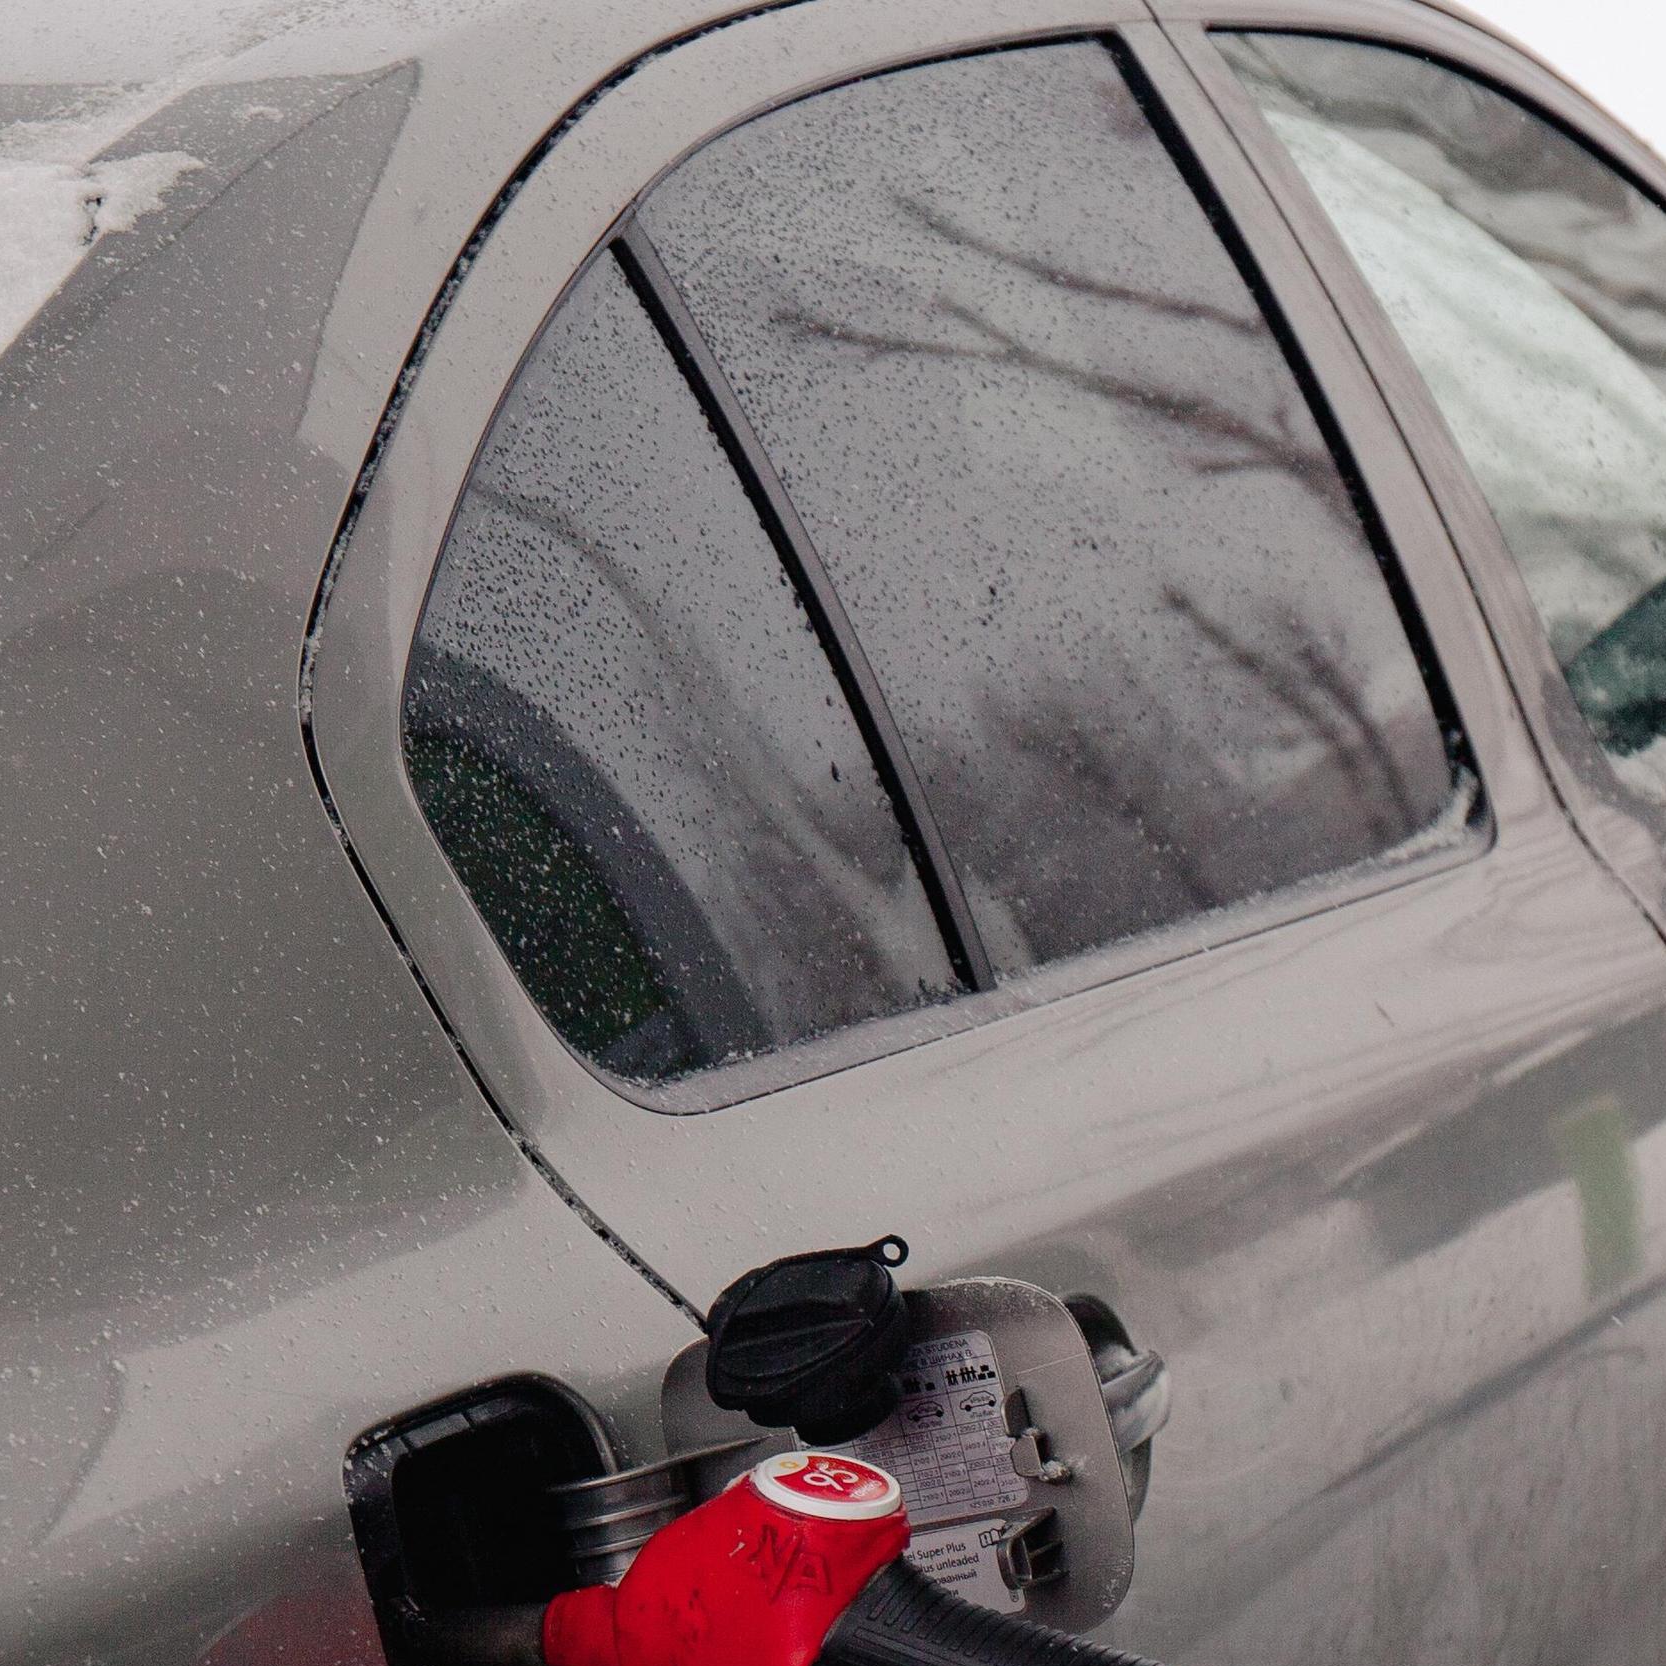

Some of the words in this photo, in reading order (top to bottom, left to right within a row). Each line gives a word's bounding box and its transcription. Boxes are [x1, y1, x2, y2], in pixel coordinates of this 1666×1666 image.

[925, 1338, 969, 1354] STUDENA
[803, 1460, 860, 1492] 95
[917, 1546, 945, 1560] Super
[946, 1542, 967, 1554] Plus
[937, 1552, 981, 1571] unleaded
[934, 1568, 978, 1585] ованный
